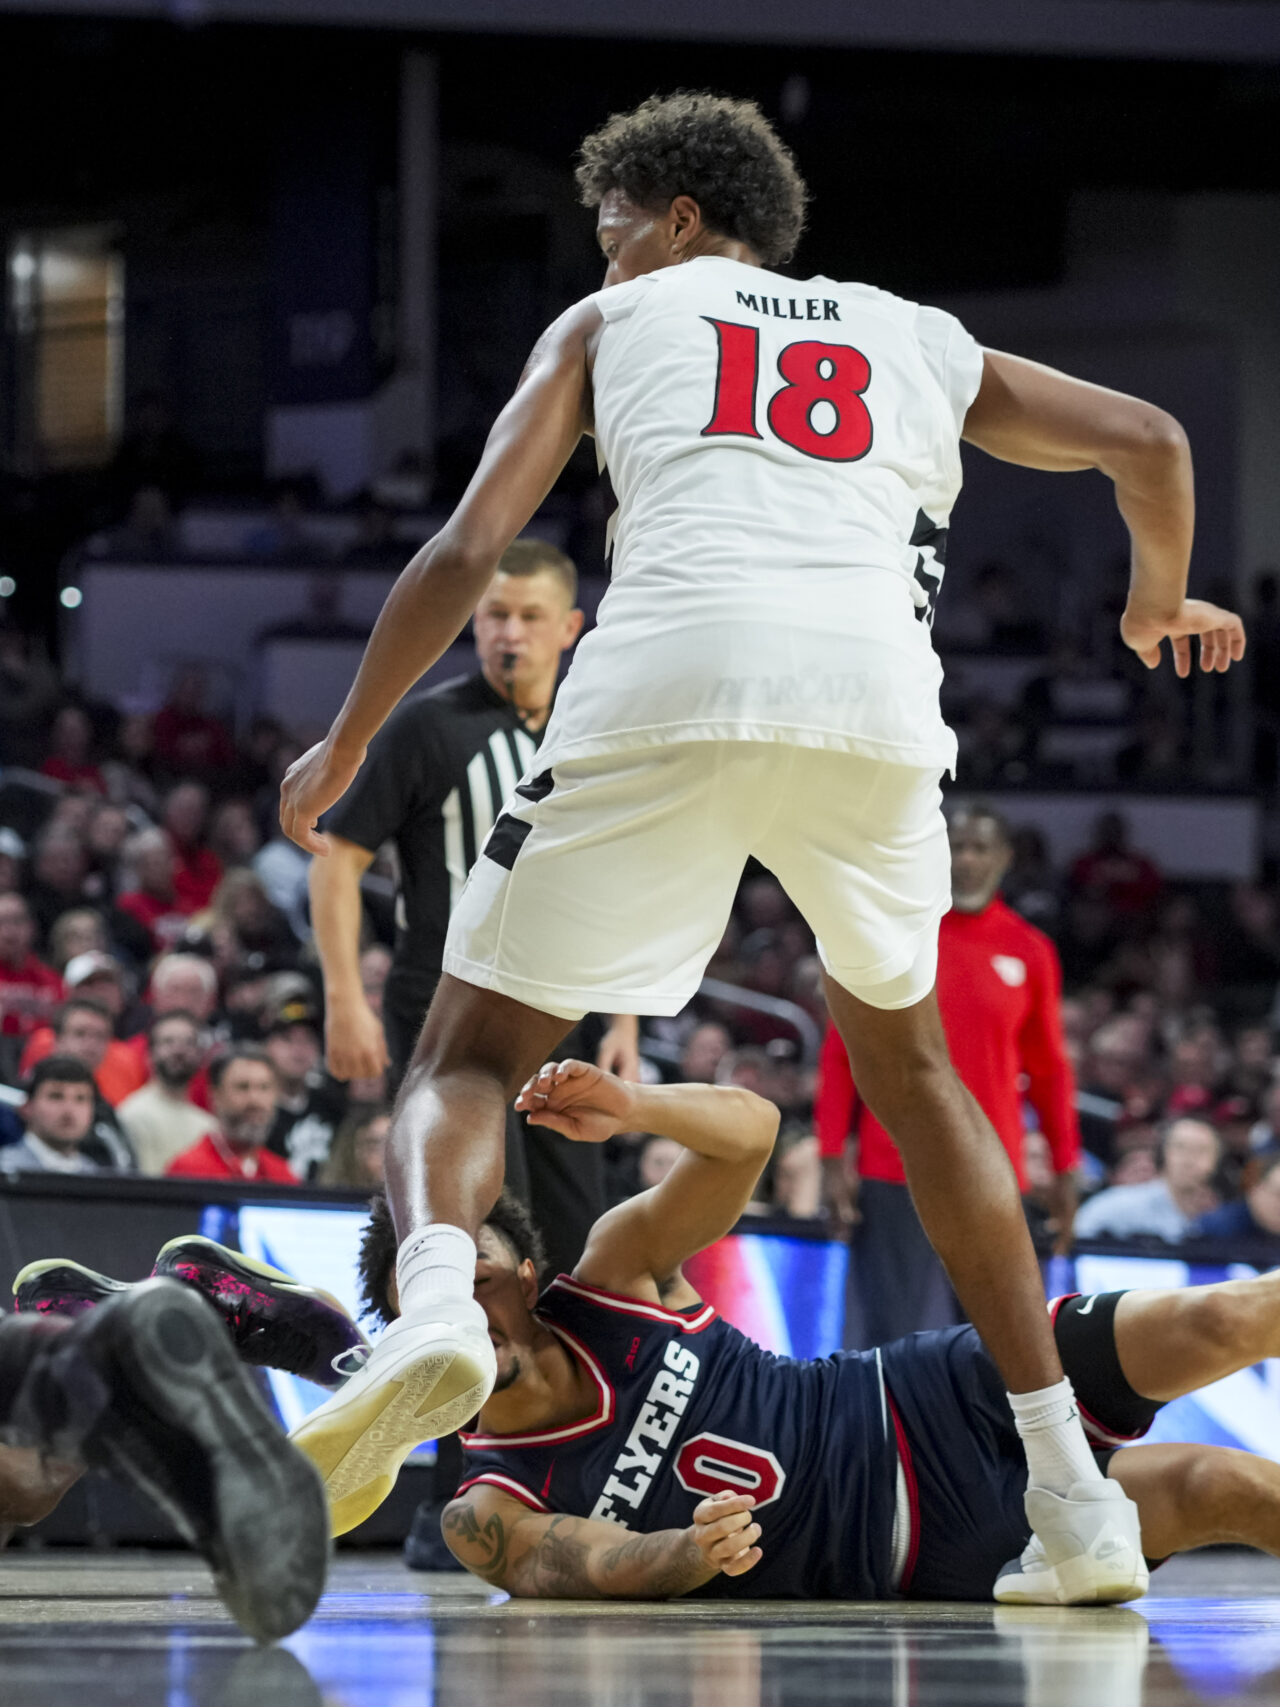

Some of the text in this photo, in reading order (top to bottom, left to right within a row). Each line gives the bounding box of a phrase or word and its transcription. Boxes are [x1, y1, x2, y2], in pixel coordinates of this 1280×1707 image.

[735, 290, 842, 321] MILLER
[699, 315, 873, 463] 18
[588, 1340, 700, 1529] FLYERS
[672, 1431, 787, 1511] 0
